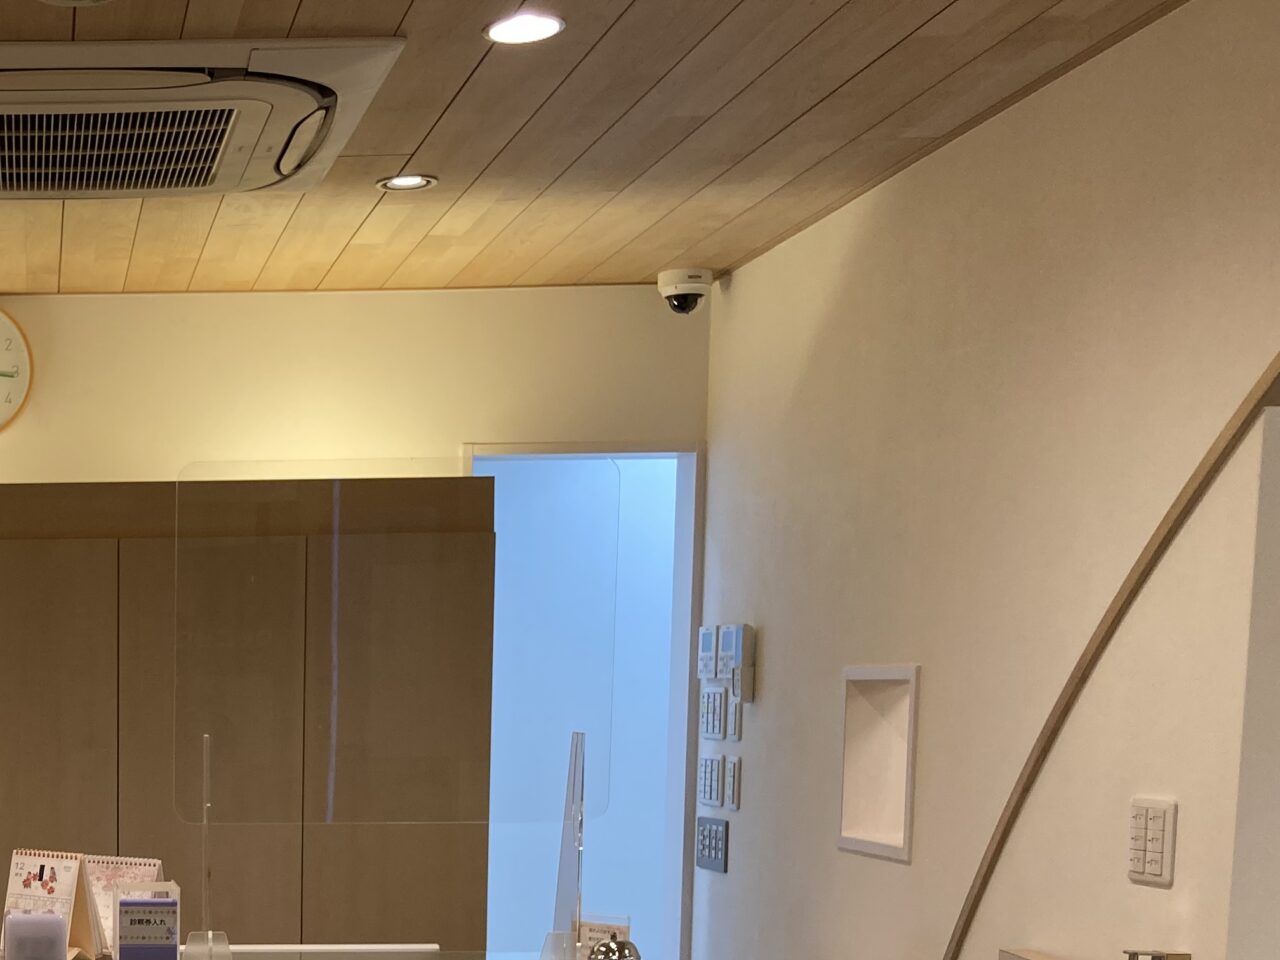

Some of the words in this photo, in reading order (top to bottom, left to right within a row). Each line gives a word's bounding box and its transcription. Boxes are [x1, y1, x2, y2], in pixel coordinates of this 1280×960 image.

[4, 338, 13, 351] 2
[11, 365, 20, 377] 3
[4, 392, 13, 404] 4
[15, 862, 25, 871] 12
[129, 918, 167, 926] 診察券入れ
